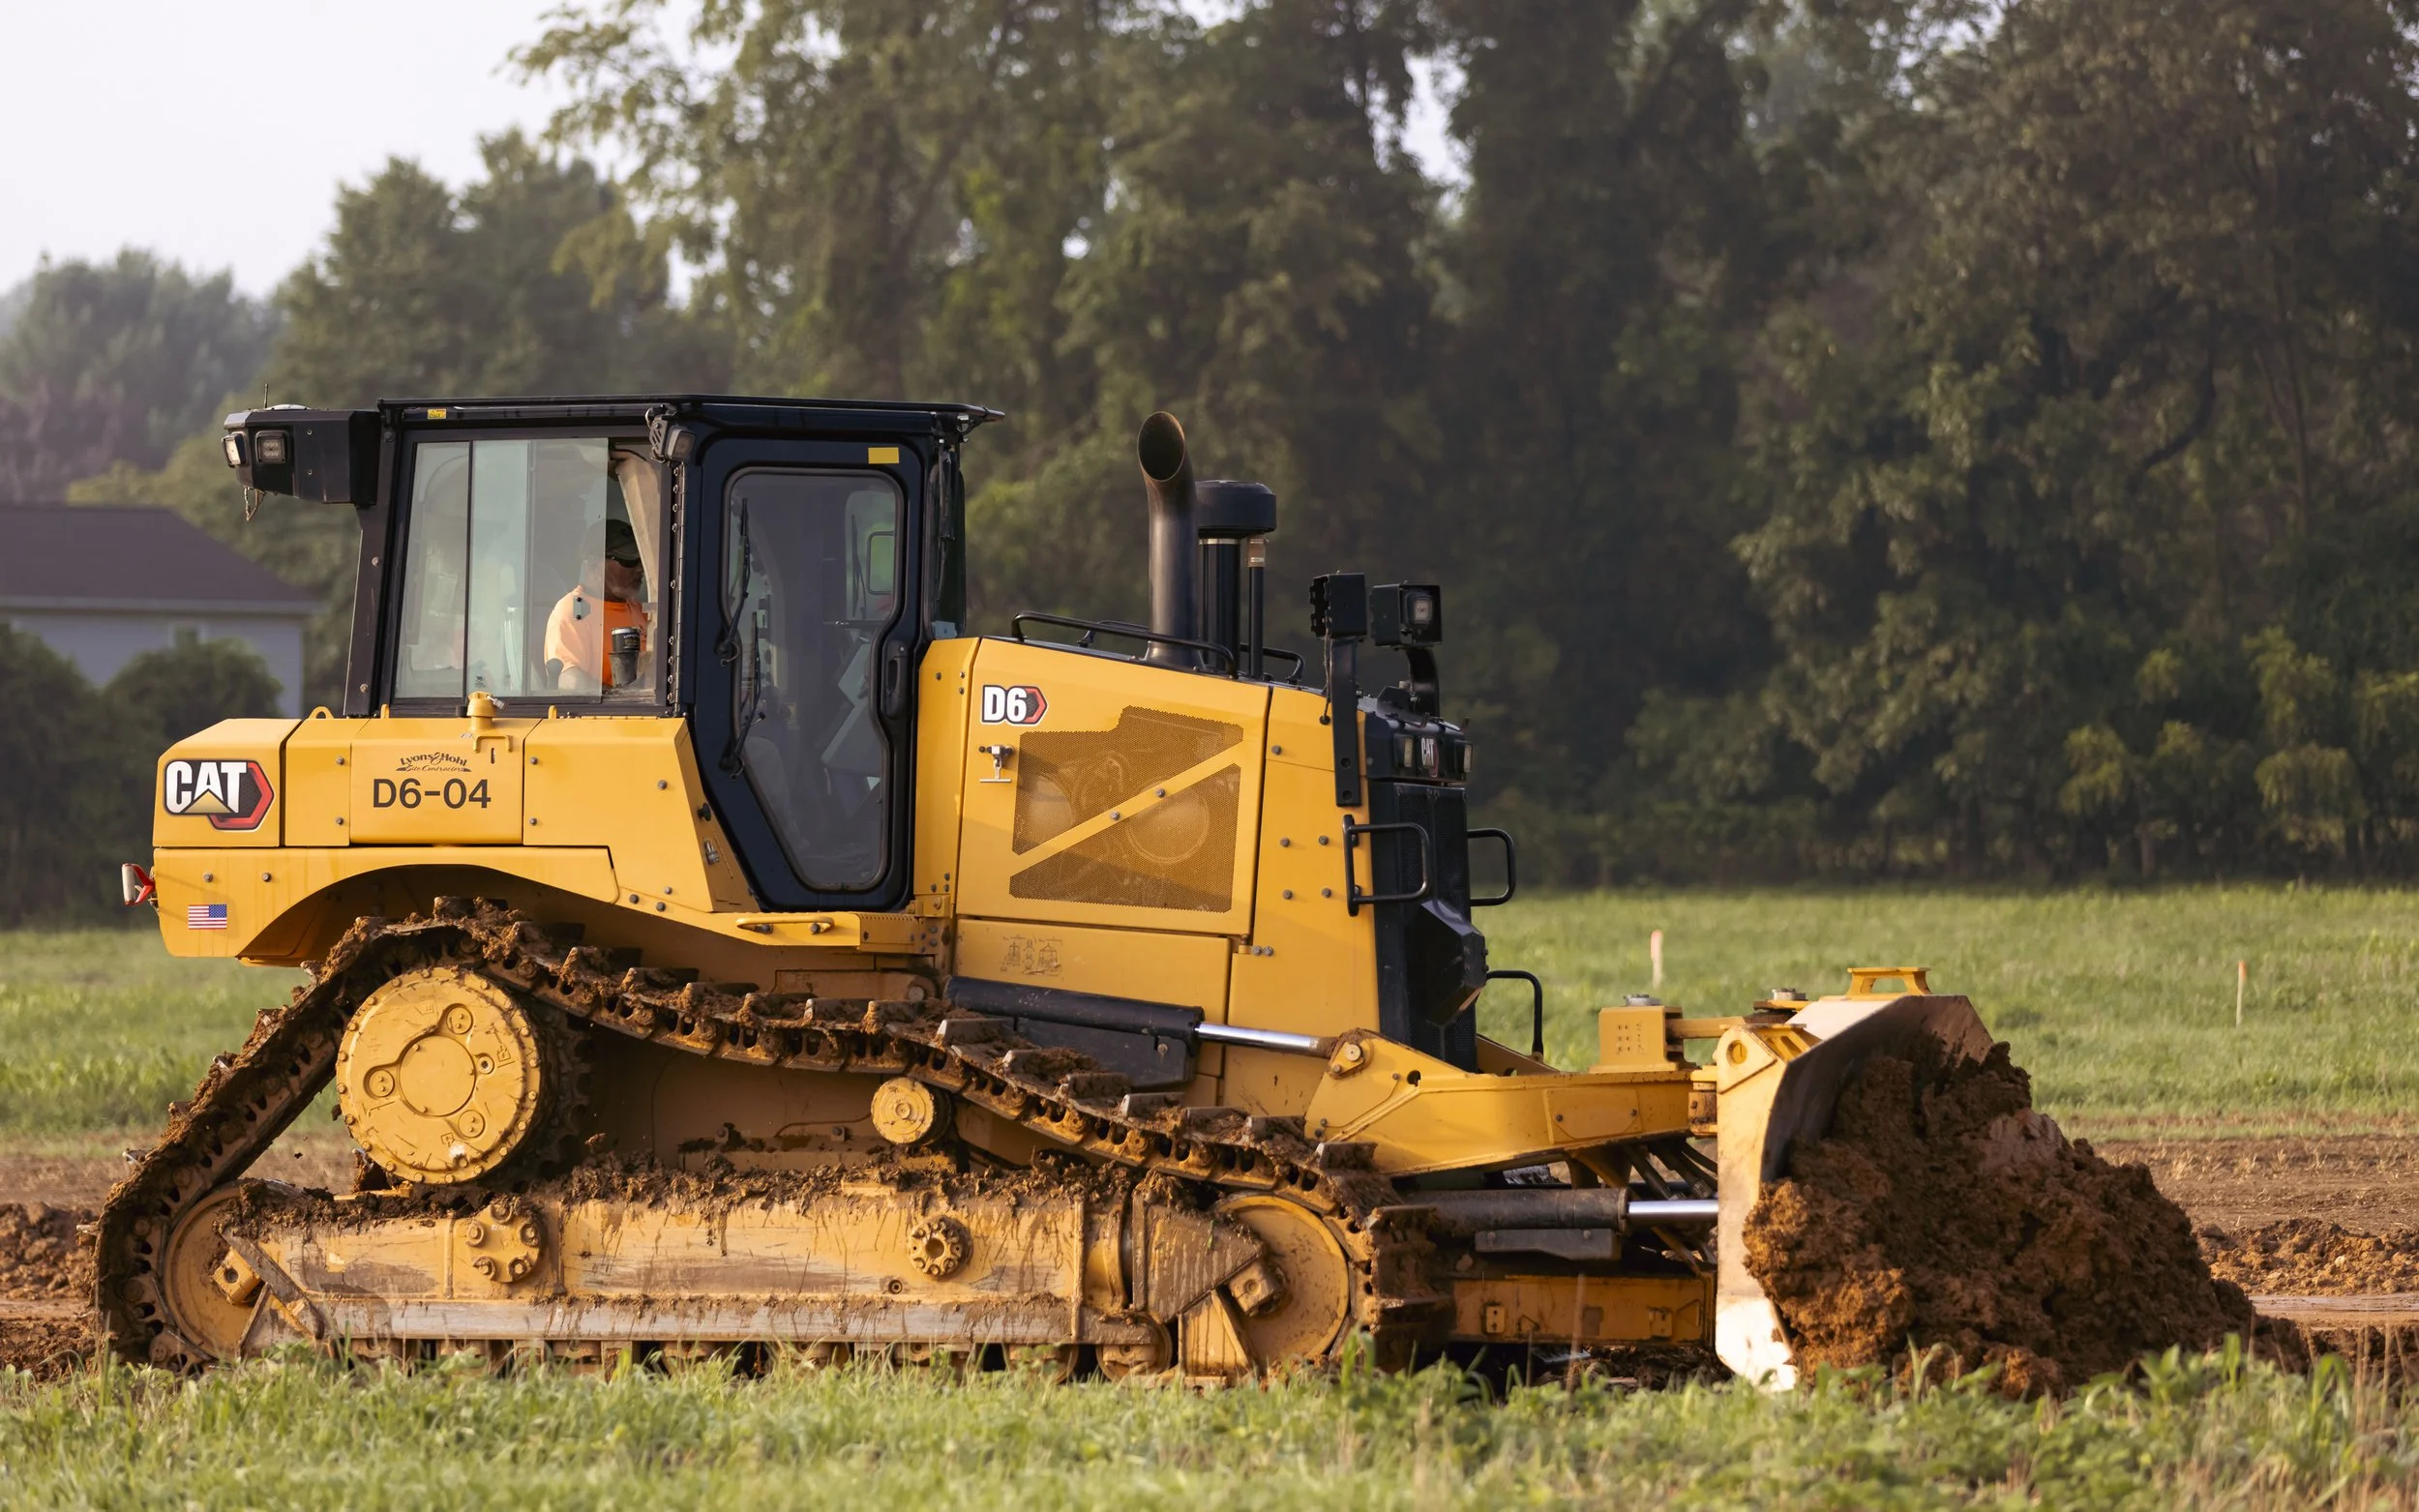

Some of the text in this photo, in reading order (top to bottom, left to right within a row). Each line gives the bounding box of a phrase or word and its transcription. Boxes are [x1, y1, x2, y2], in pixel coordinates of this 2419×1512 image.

[983, 686, 1028, 723] D6
[400, 754, 433, 765] Lyons
[441, 753, 467, 766] Hohl
[1420, 737, 1435, 767] CAT
[165, 760, 247, 814] CAT
[373, 778, 492, 809] D6-04
